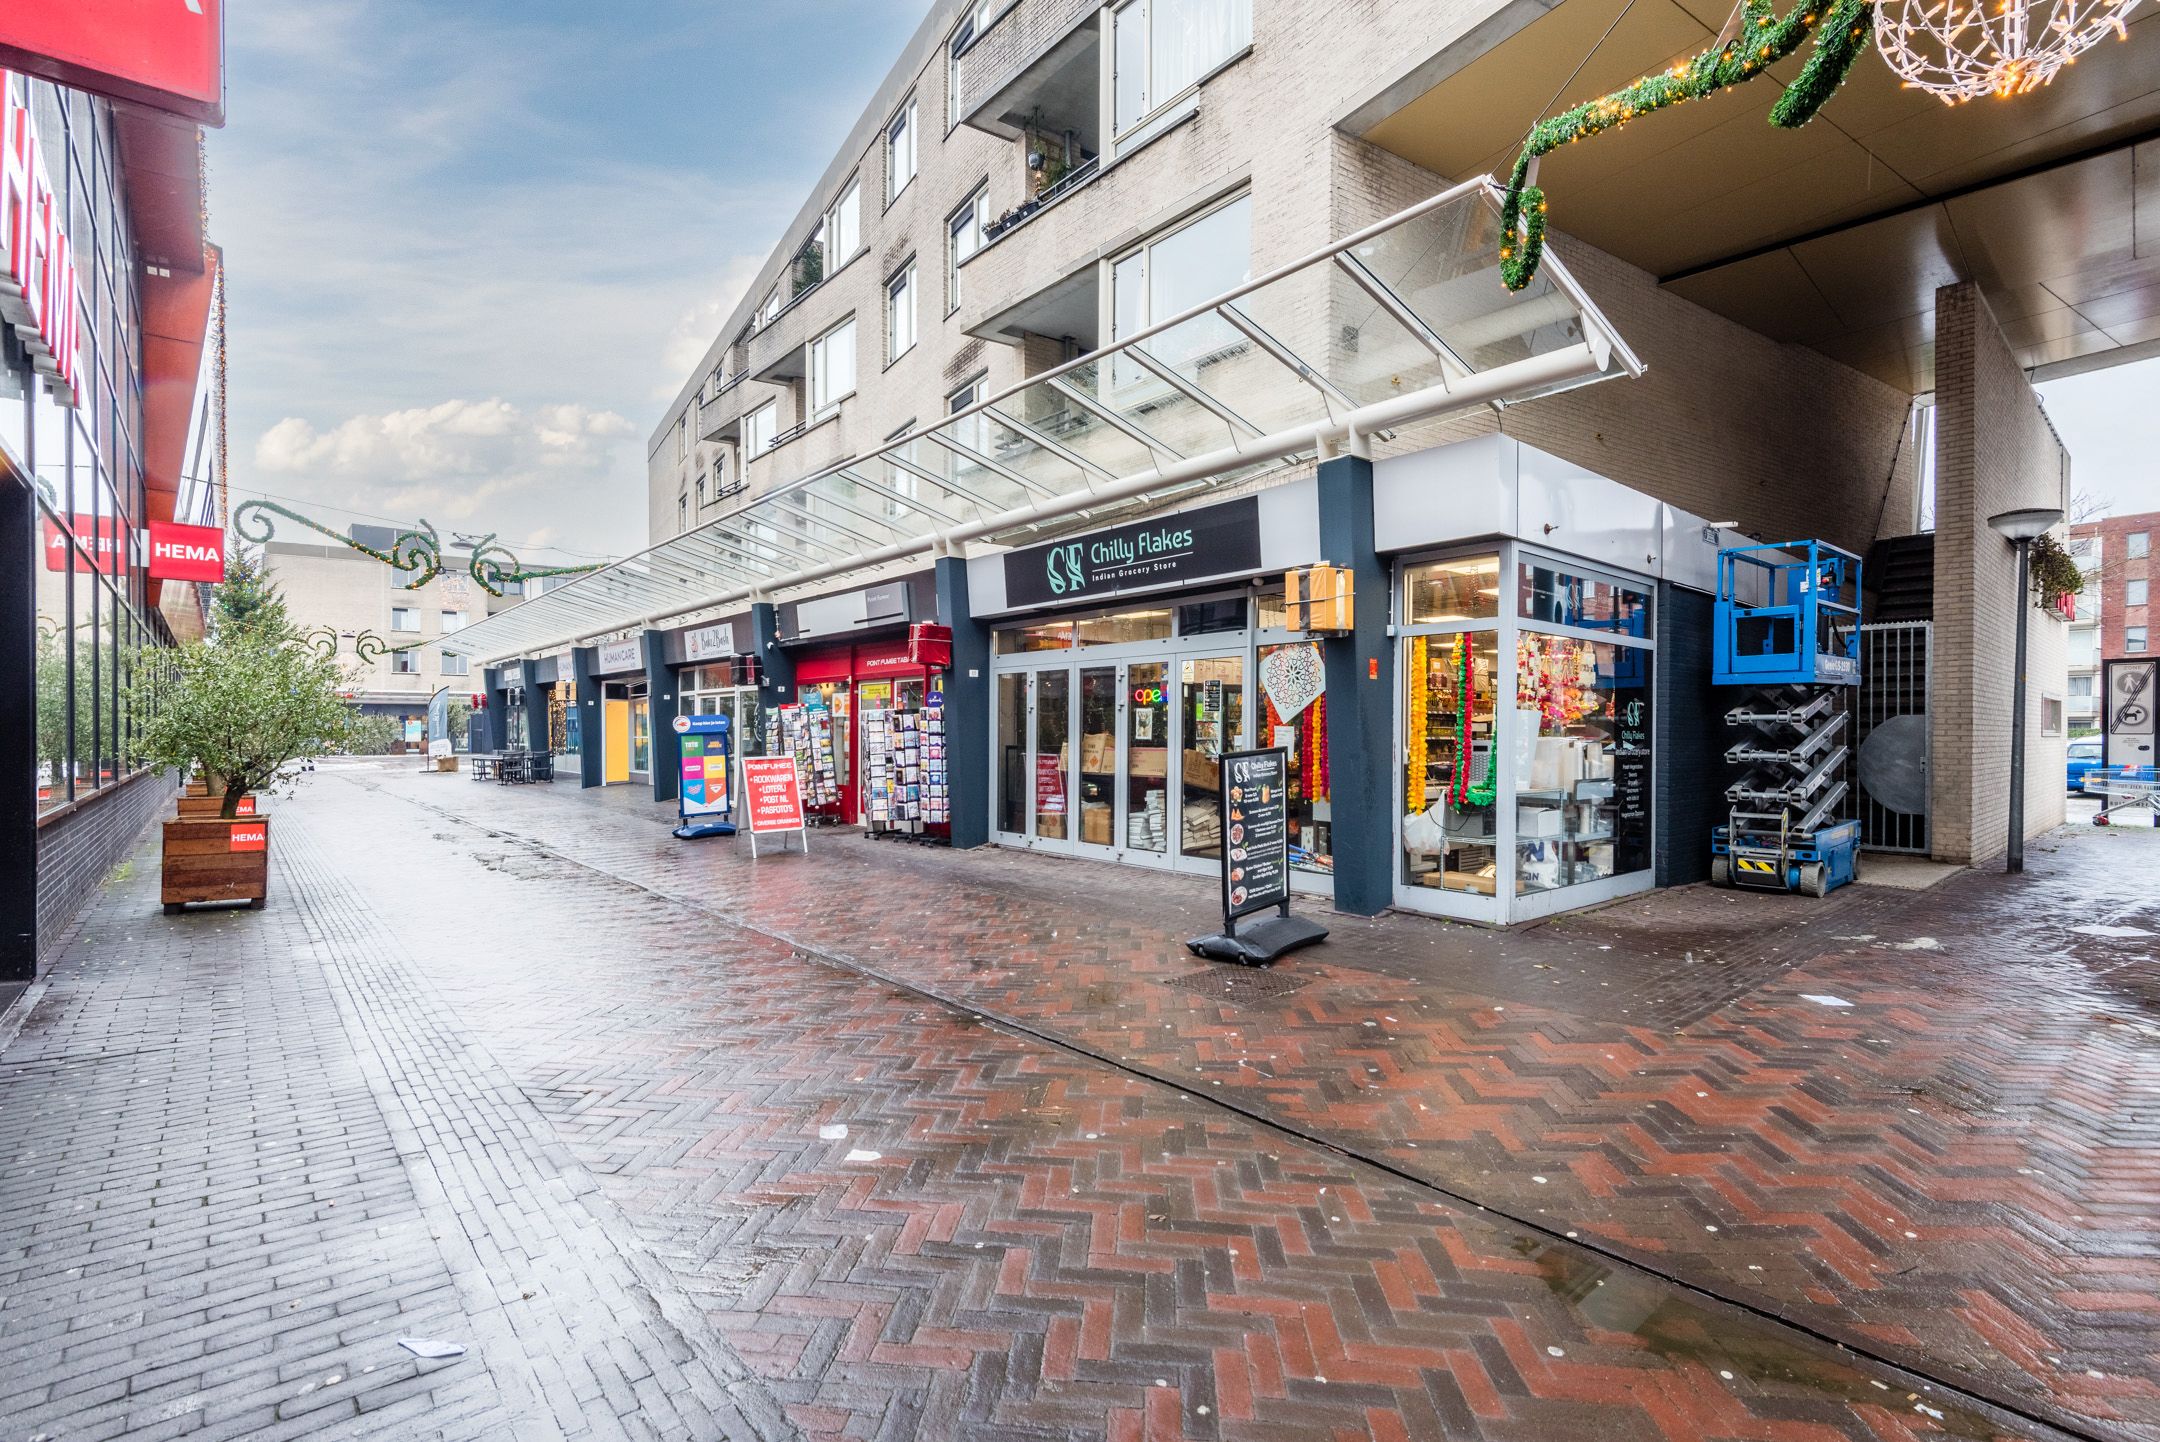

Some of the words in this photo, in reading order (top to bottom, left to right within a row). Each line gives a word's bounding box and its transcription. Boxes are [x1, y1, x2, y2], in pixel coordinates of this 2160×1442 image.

[1091, 537, 1134, 564] Chilly
[1139, 528, 1193, 556] Flakes
[155, 542, 220, 562] HEMA
[1092, 571, 1116, 582] Indian
[1118, 565, 1150, 577] Grocery
[1153, 561, 1177, 571] Store
[753, 773, 793, 784] ROOKWAREN
[762, 784, 787, 793] LOTERIJ
[763, 795, 778, 804] POST
[780, 794, 789, 802] NL
[232, 833, 265, 842] HEMA
